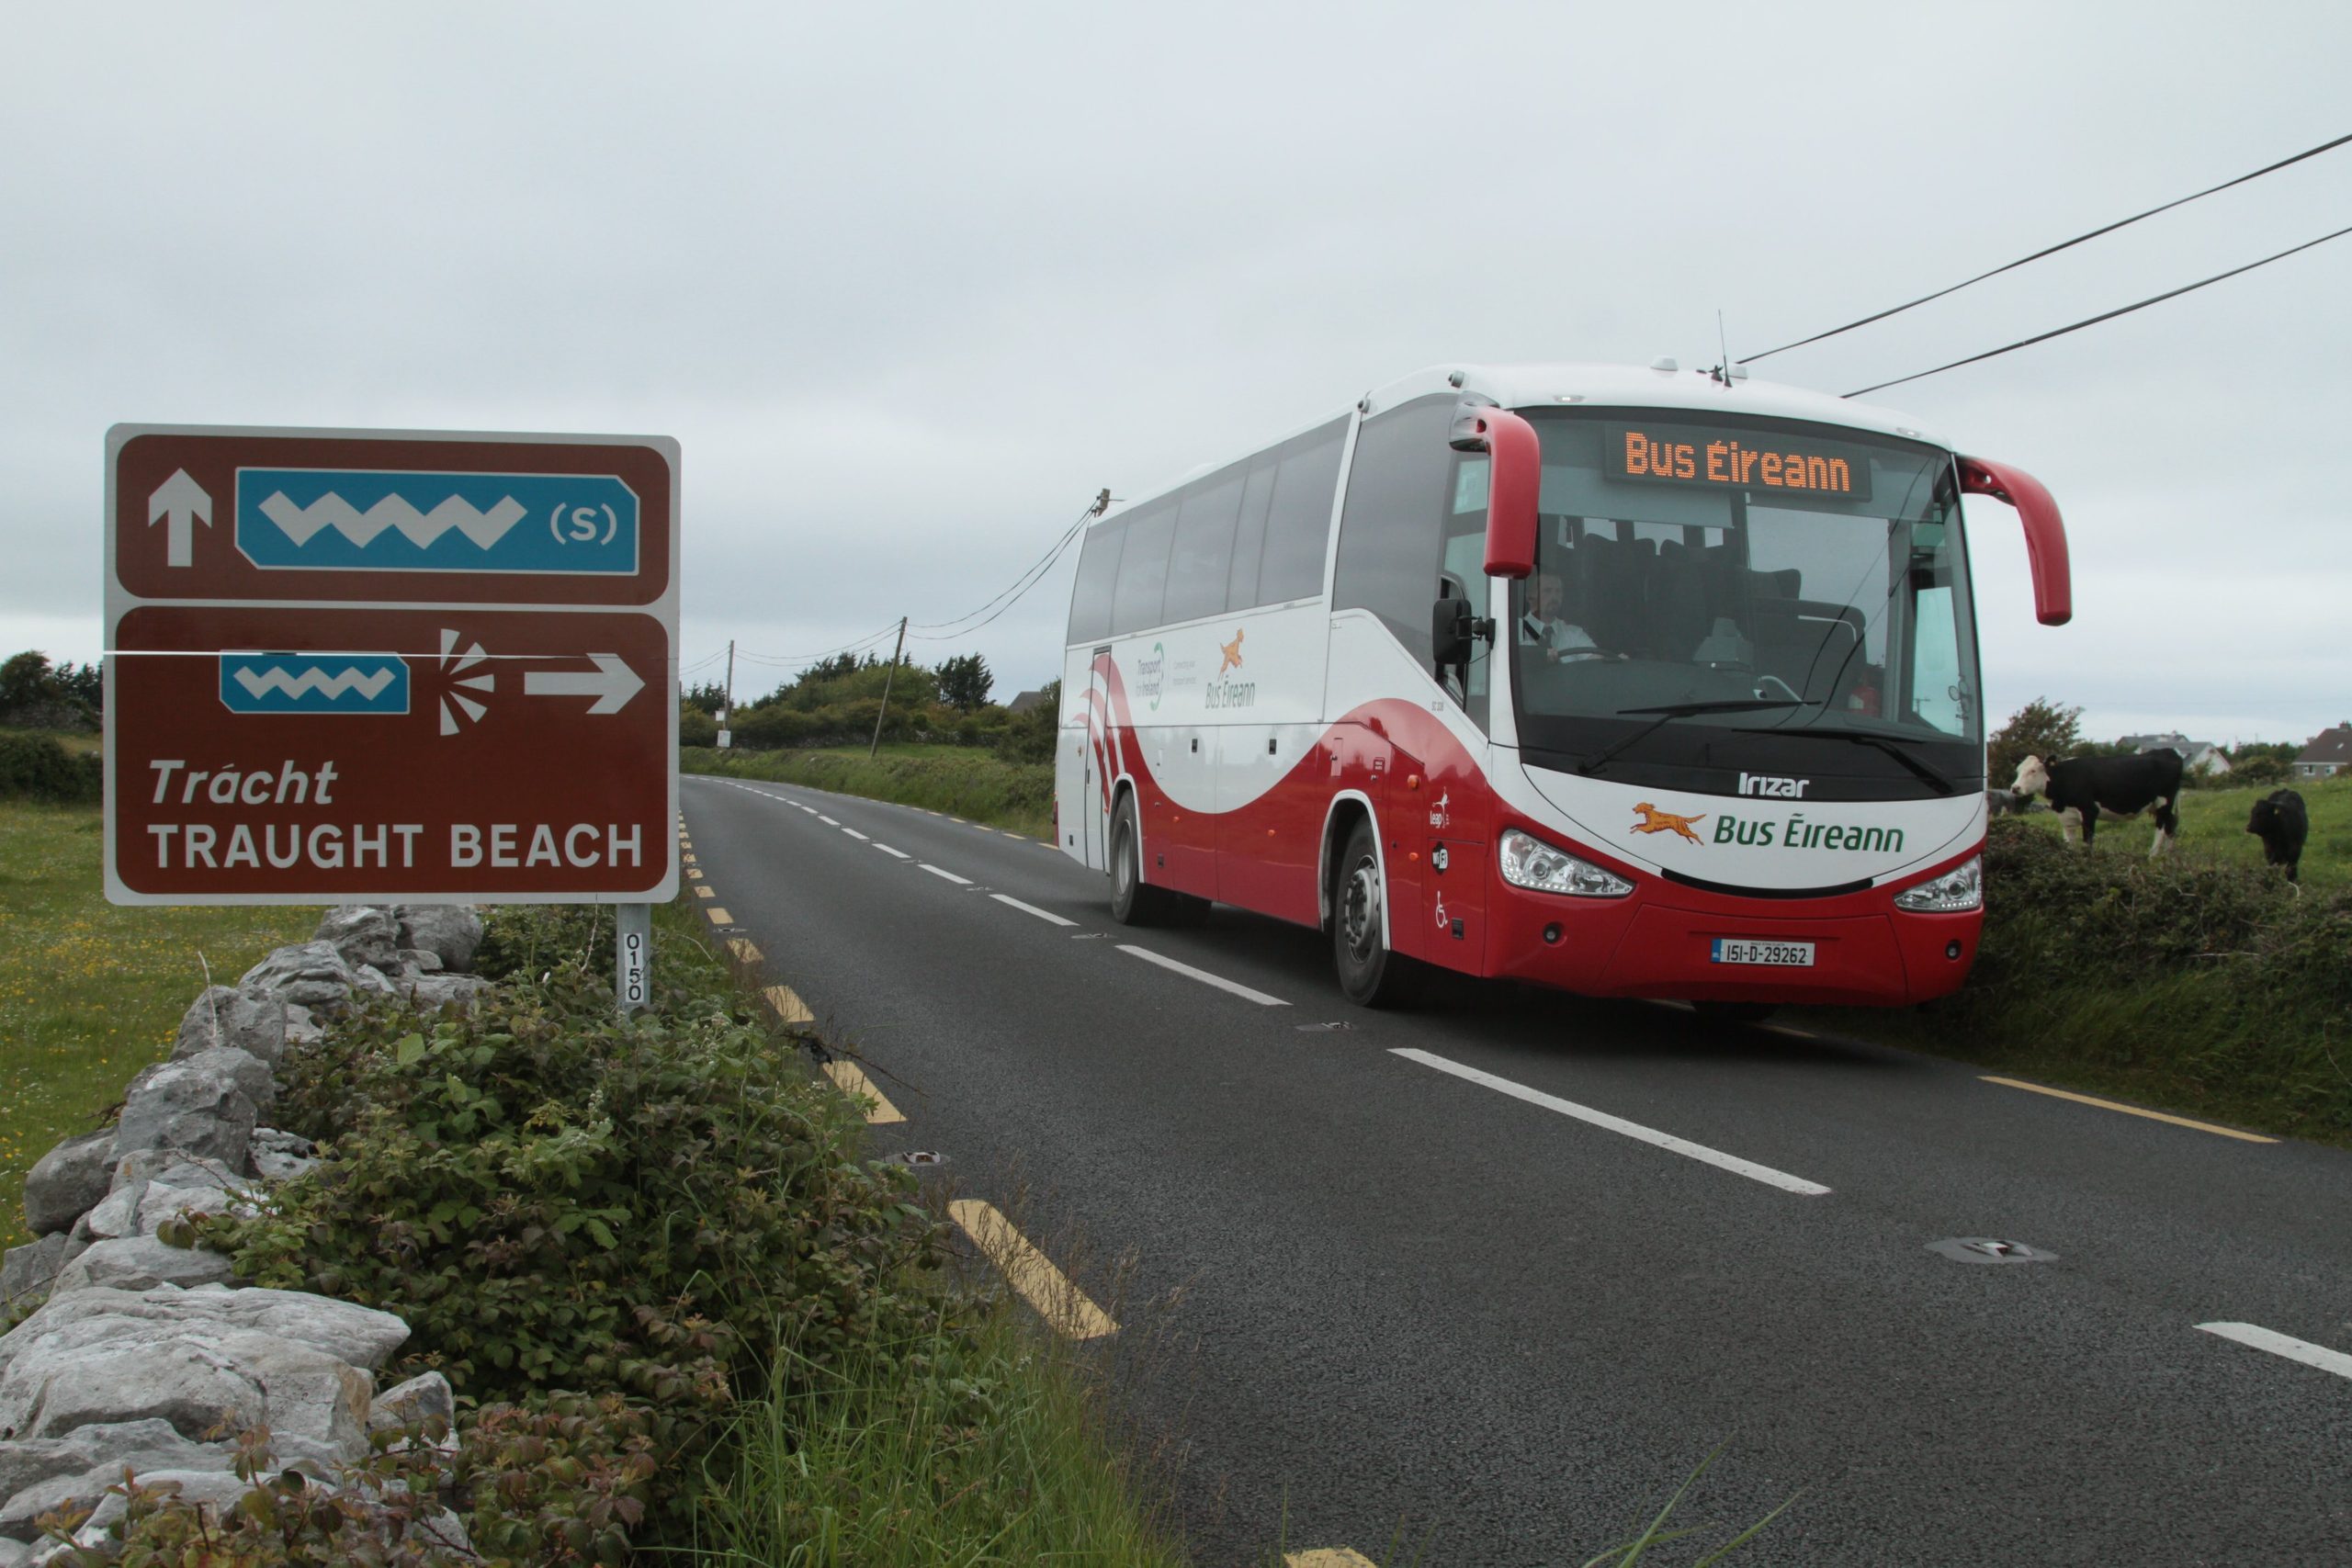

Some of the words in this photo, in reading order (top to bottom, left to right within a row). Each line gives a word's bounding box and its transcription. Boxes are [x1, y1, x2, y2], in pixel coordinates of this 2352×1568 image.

[1625, 432, 1695, 478] Bus
[1706, 440, 1850, 491] Éireann
[550, 502, 617, 546] (S)
[1205, 682, 1221, 709] Bus
[149, 760, 338, 805] Trácht
[1738, 772, 1810, 798] Irizar
[147, 824, 423, 869] TRAUGHT
[450, 824, 642, 868] BEACH
[1713, 814, 1776, 846] Bus
[1727, 944, 1807, 964] 151-D-29262
